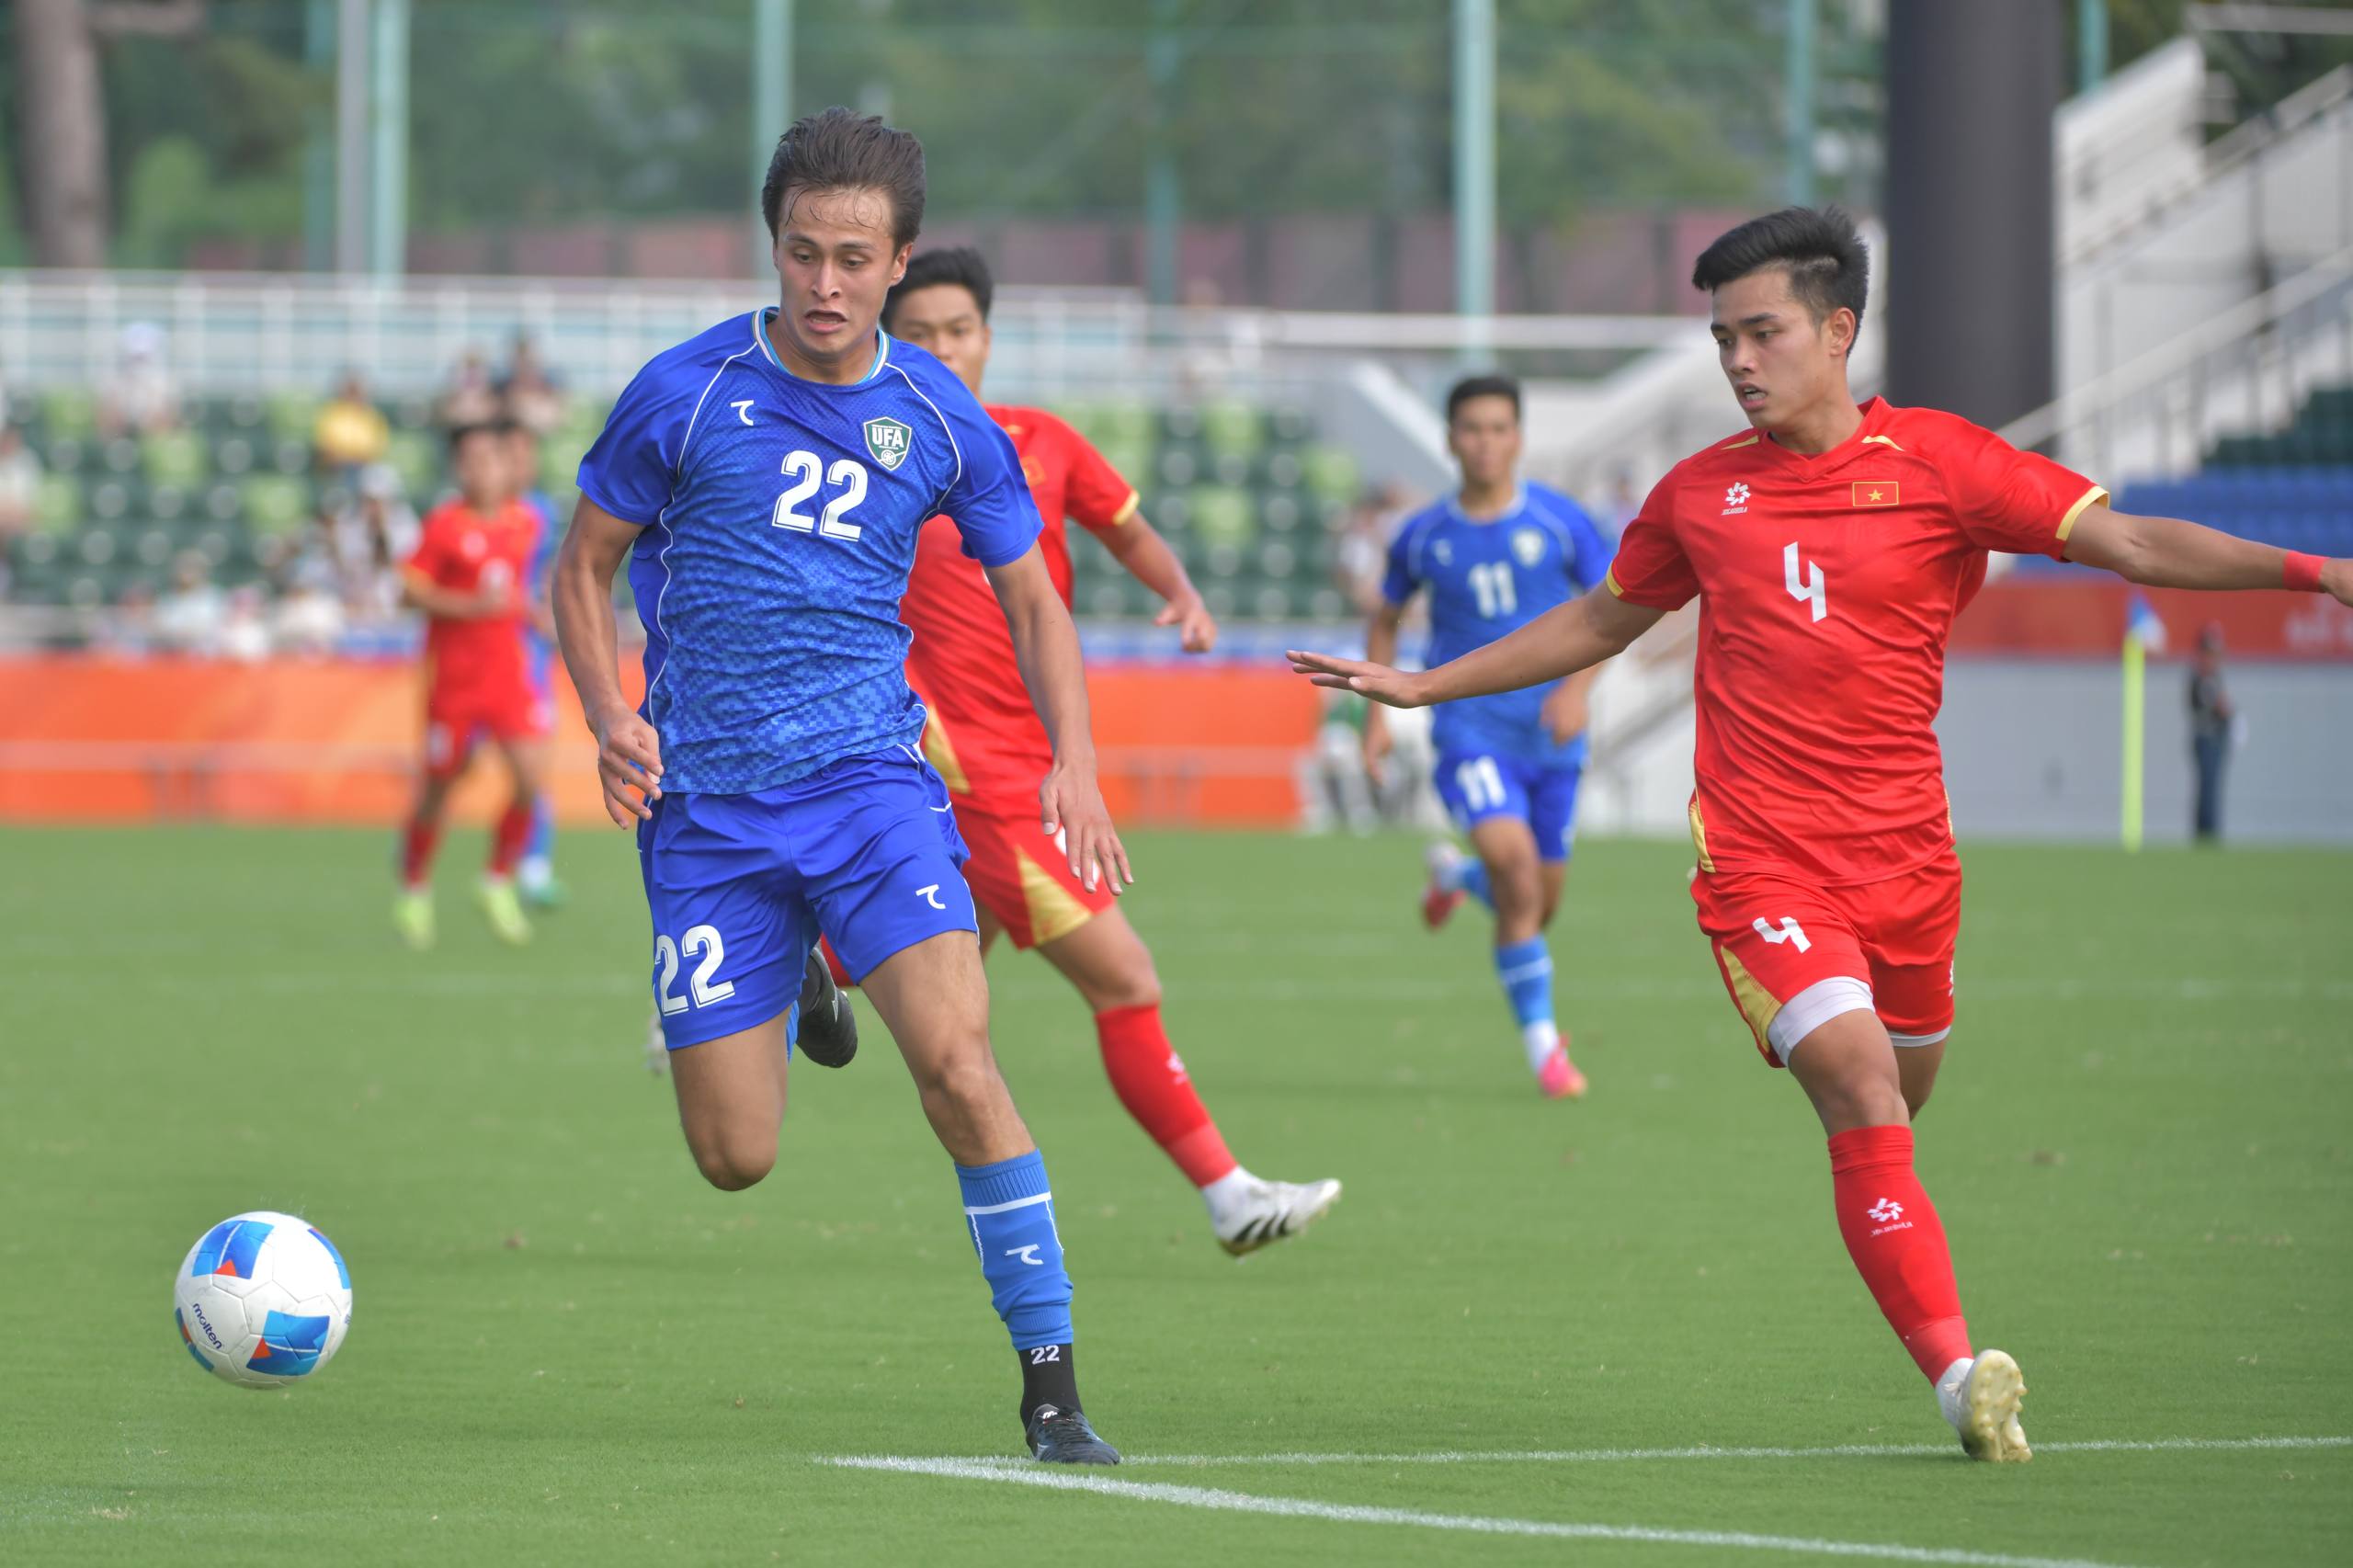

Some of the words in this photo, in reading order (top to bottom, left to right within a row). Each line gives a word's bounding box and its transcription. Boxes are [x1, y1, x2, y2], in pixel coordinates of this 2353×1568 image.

[871, 426, 904, 448] UFA
[772, 450, 868, 541] 22
[1469, 562, 1516, 619] 11
[1783, 541, 1827, 623] 4
[1457, 756, 1507, 812] 11
[1752, 916, 1812, 954] 4
[654, 925, 735, 1017] 22
[192, 1302, 222, 1349] molten
[1030, 1345, 1060, 1365] 22
